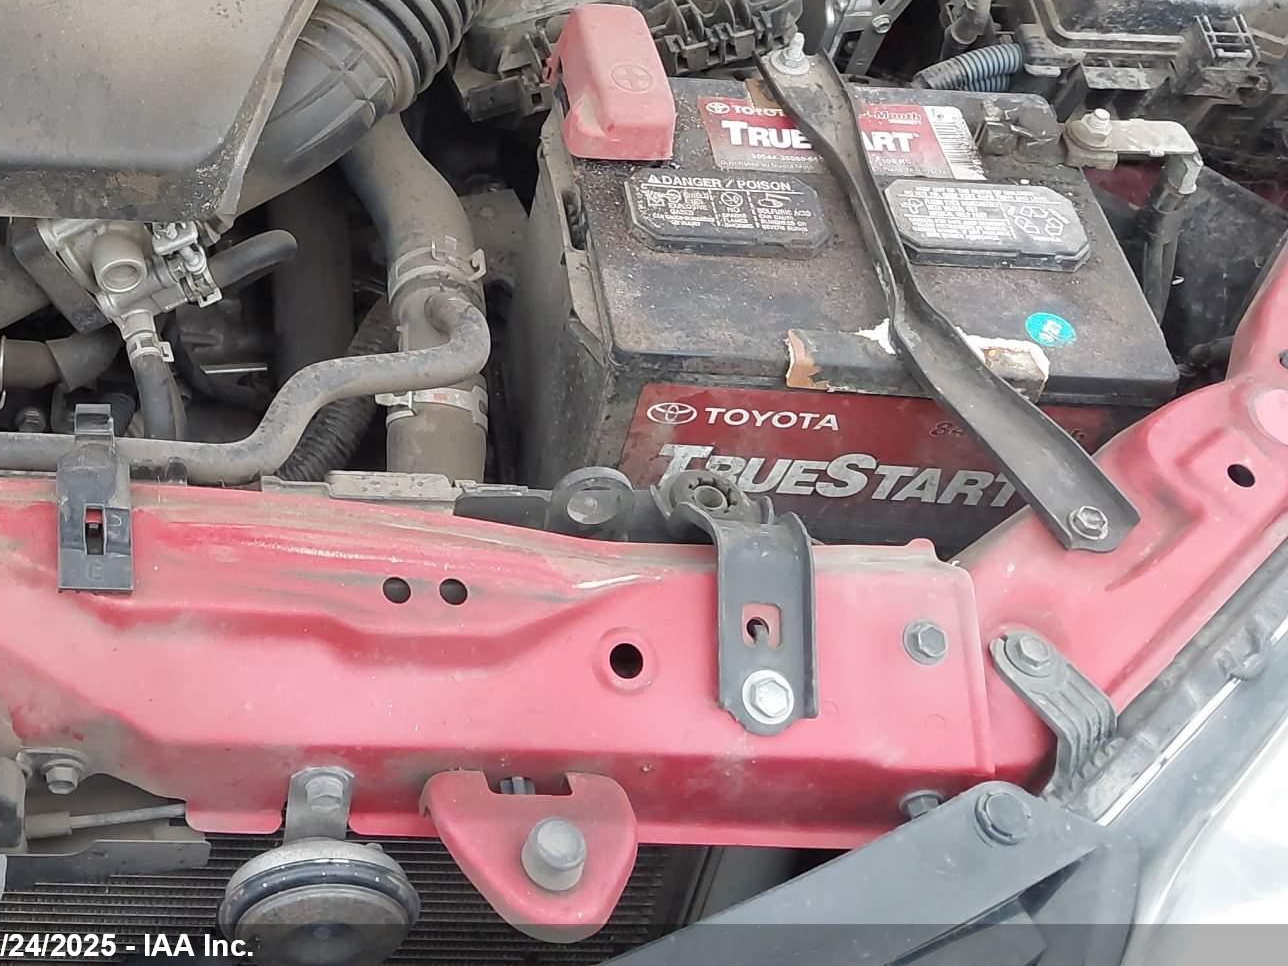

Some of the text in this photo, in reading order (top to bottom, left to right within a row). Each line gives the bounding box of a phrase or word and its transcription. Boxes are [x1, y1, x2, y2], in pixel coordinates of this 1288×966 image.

[732, 104, 786, 117] TOYOT
[661, 175, 722, 189] DANGER
[737, 179, 792, 192] POISON
[704, 407, 839, 431] TOYOTA
